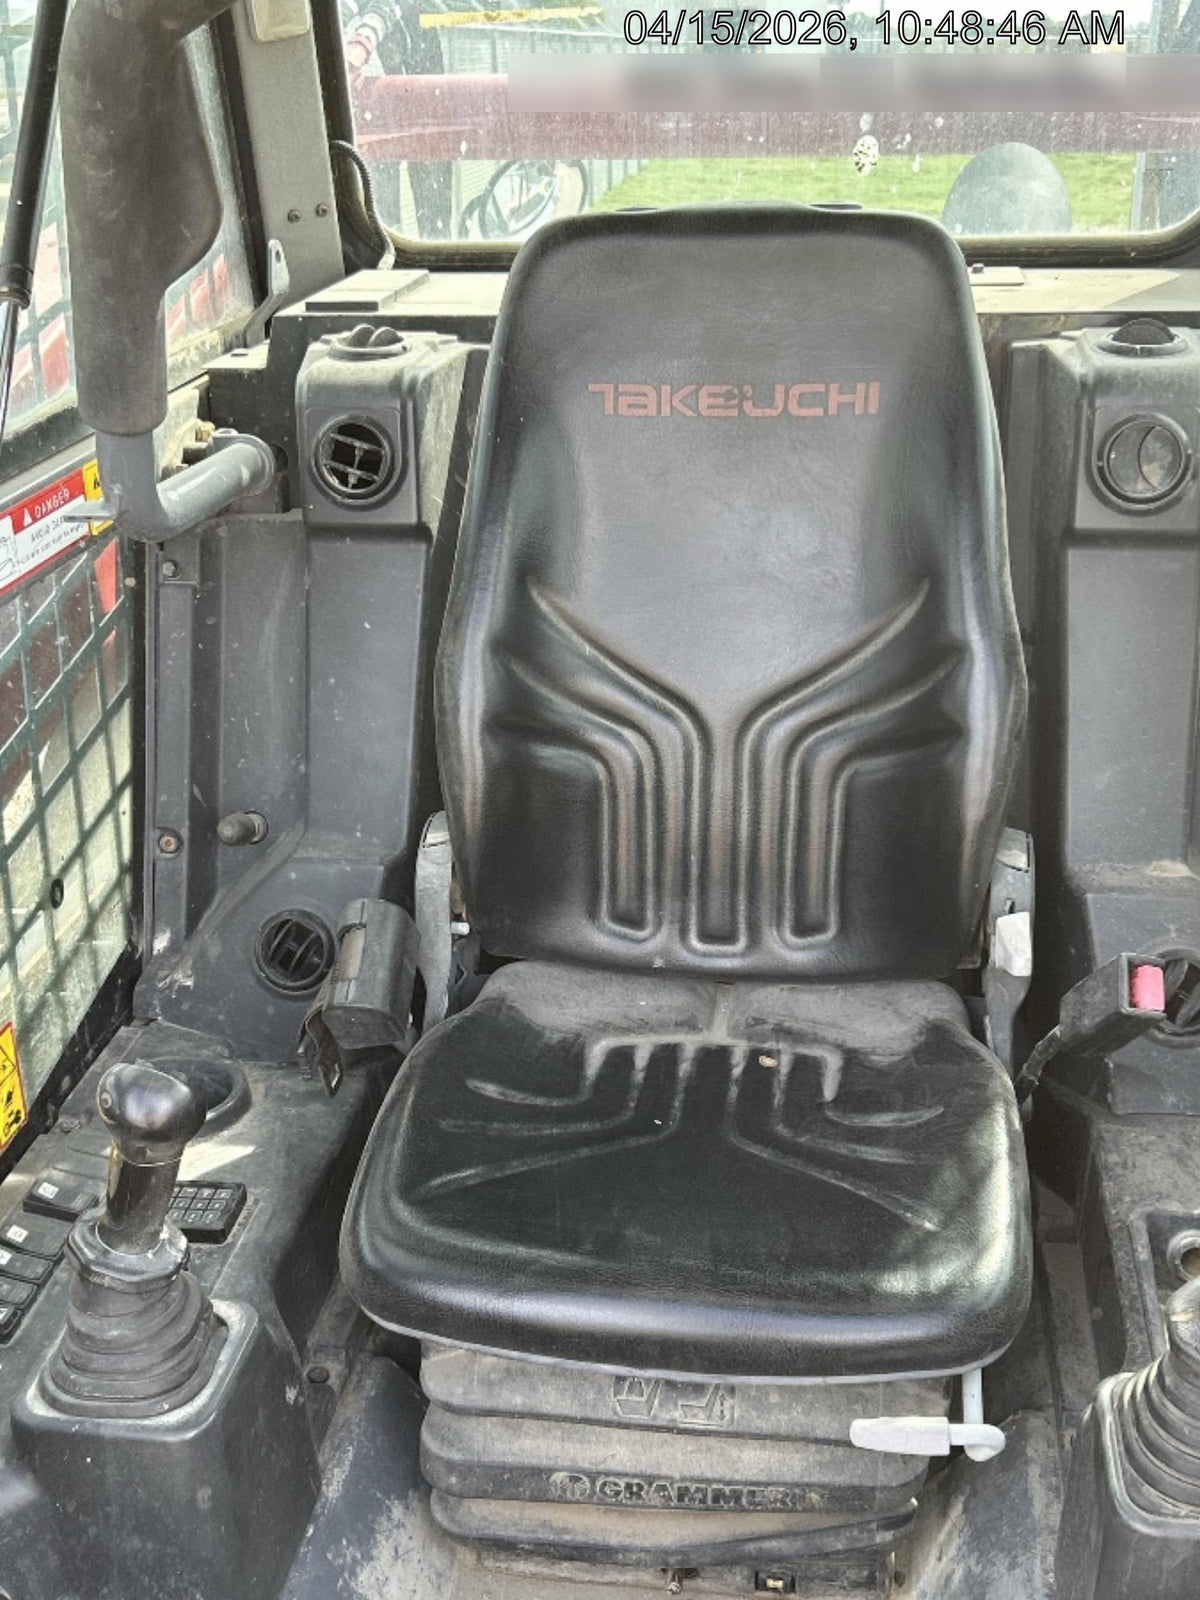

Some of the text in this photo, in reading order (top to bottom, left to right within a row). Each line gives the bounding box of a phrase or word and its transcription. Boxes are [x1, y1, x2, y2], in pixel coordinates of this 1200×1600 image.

[588, 382, 880, 417] TAKEUCHI
[34, 489, 70, 519] DANGER
[598, 1477, 795, 1509] GRAMMER
